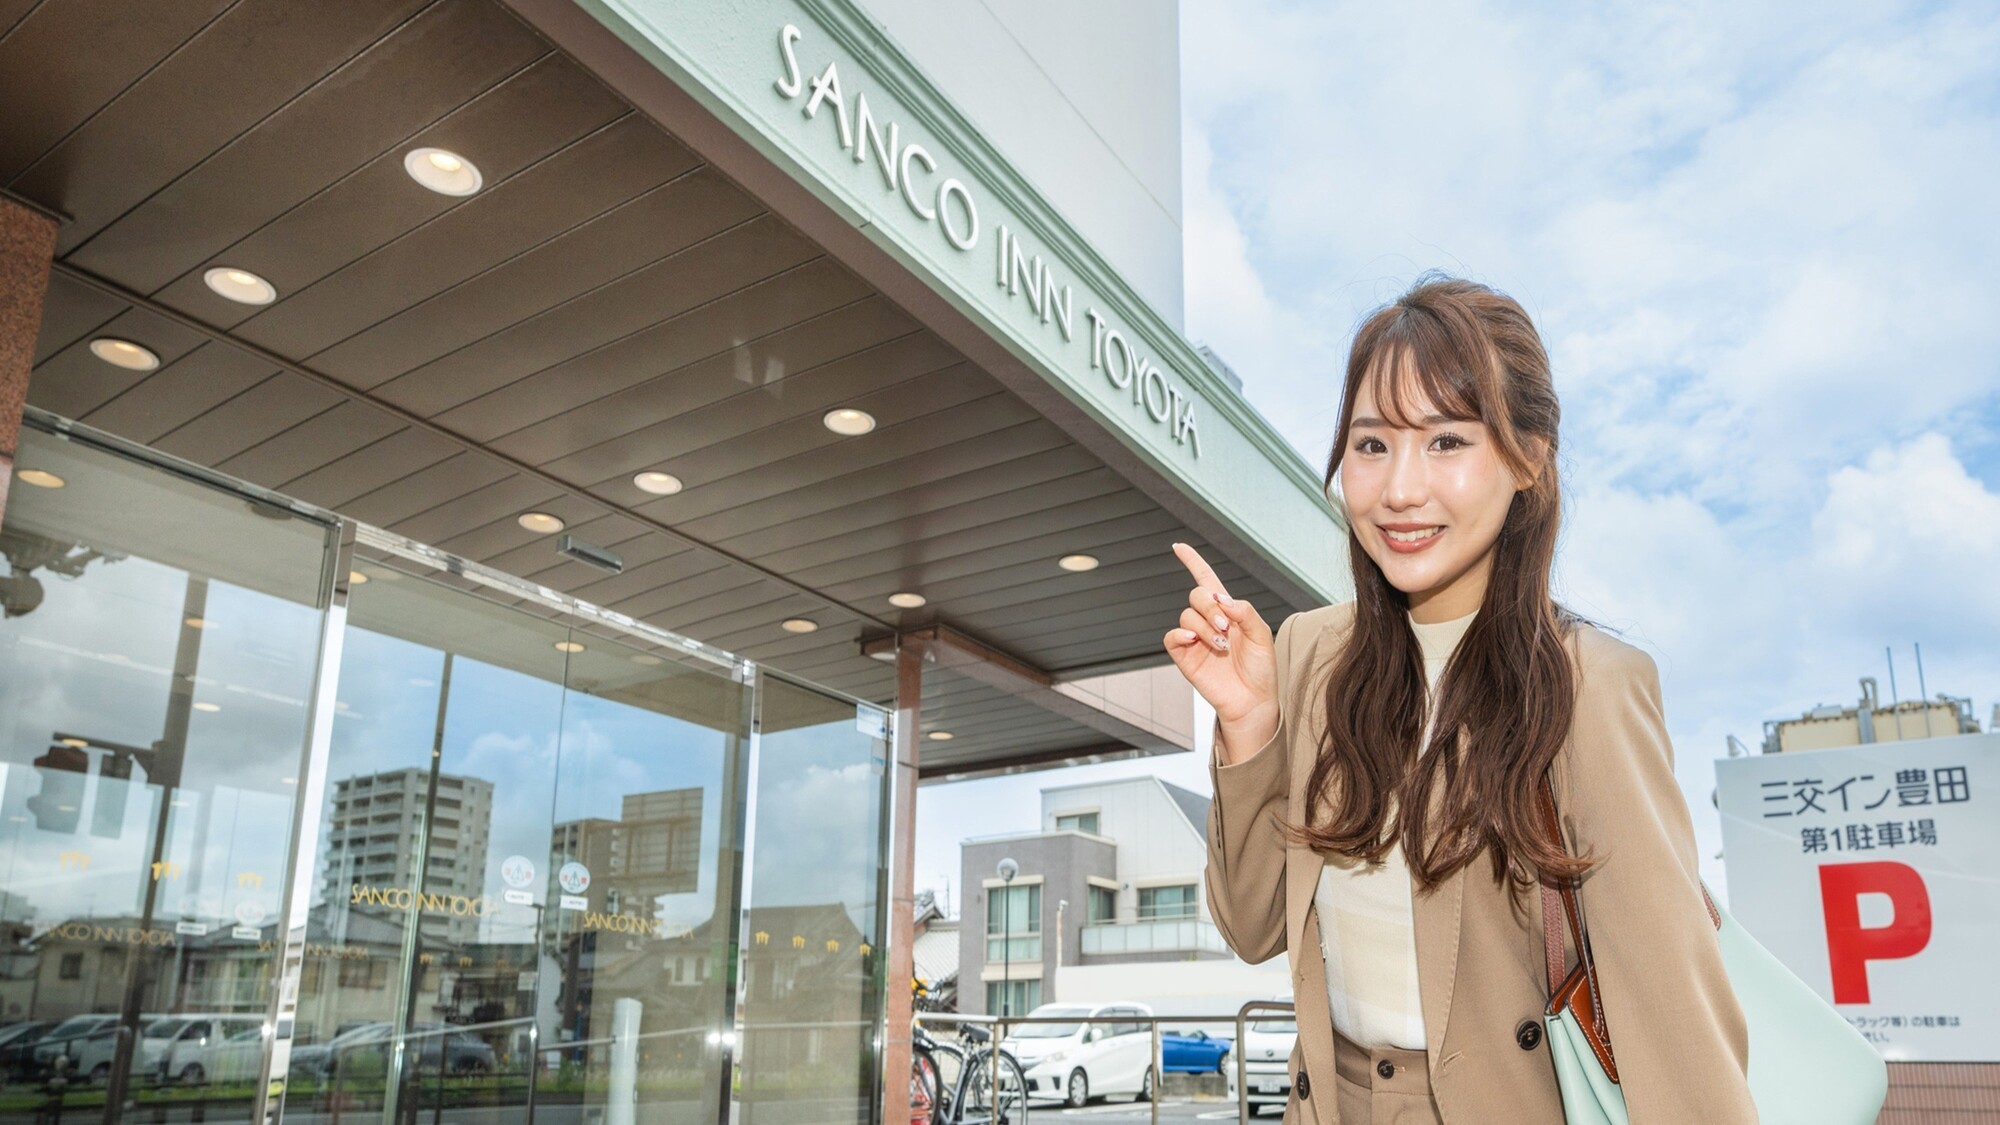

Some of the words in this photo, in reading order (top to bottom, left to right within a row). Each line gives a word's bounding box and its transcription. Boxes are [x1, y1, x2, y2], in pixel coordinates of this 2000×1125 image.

[774, 23, 979, 251] SANCO
[996, 223, 1072, 342] INN
[1085, 306, 1202, 458] TOYOTA
[1761, 765, 1970, 818] 三交イン豊田
[1801, 818, 1937, 853] 第1駐車場
[351, 883, 412, 910] SANCO
[415, 891, 446, 912] INN
[583, 911, 628, 932] SANCO
[1818, 861, 1932, 1005] P
